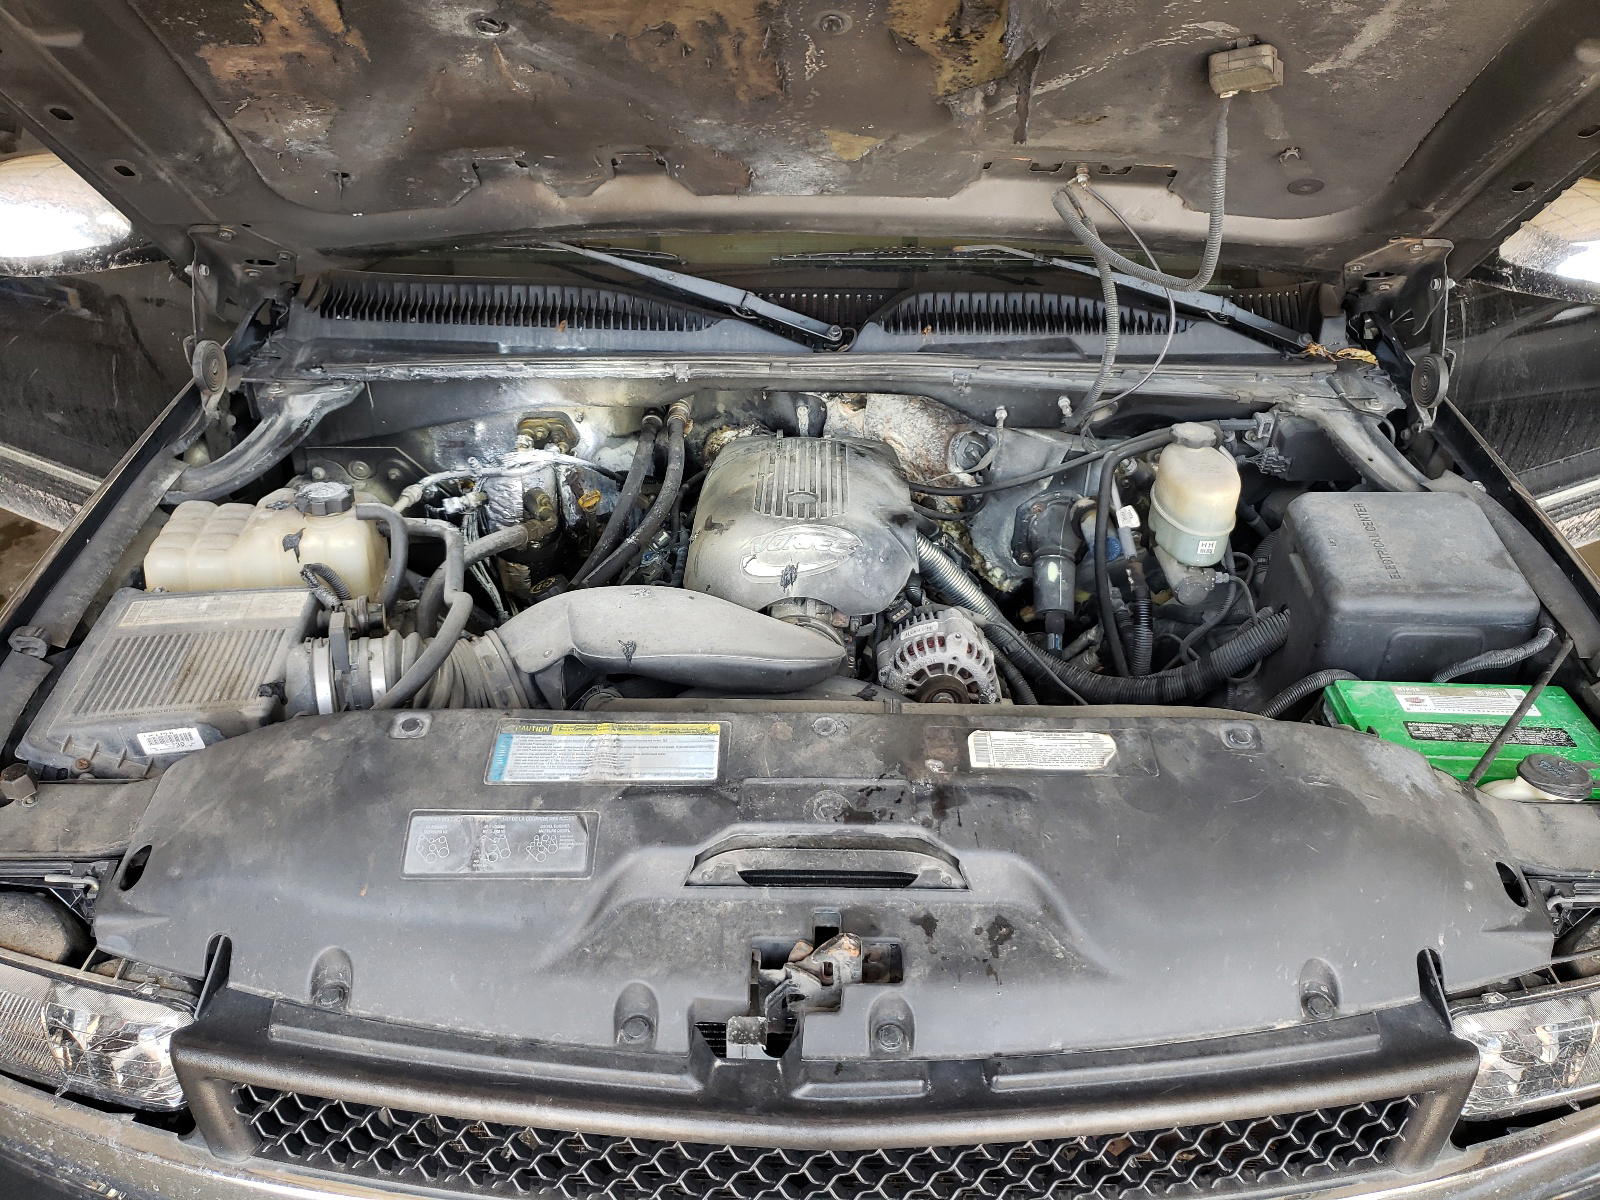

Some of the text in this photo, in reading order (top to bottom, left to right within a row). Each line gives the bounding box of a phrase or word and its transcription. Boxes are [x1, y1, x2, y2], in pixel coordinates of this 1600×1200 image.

[1353, 503, 1402, 580] ELECTRICAL CENTER
[514, 724, 550, 732] CAUTION
